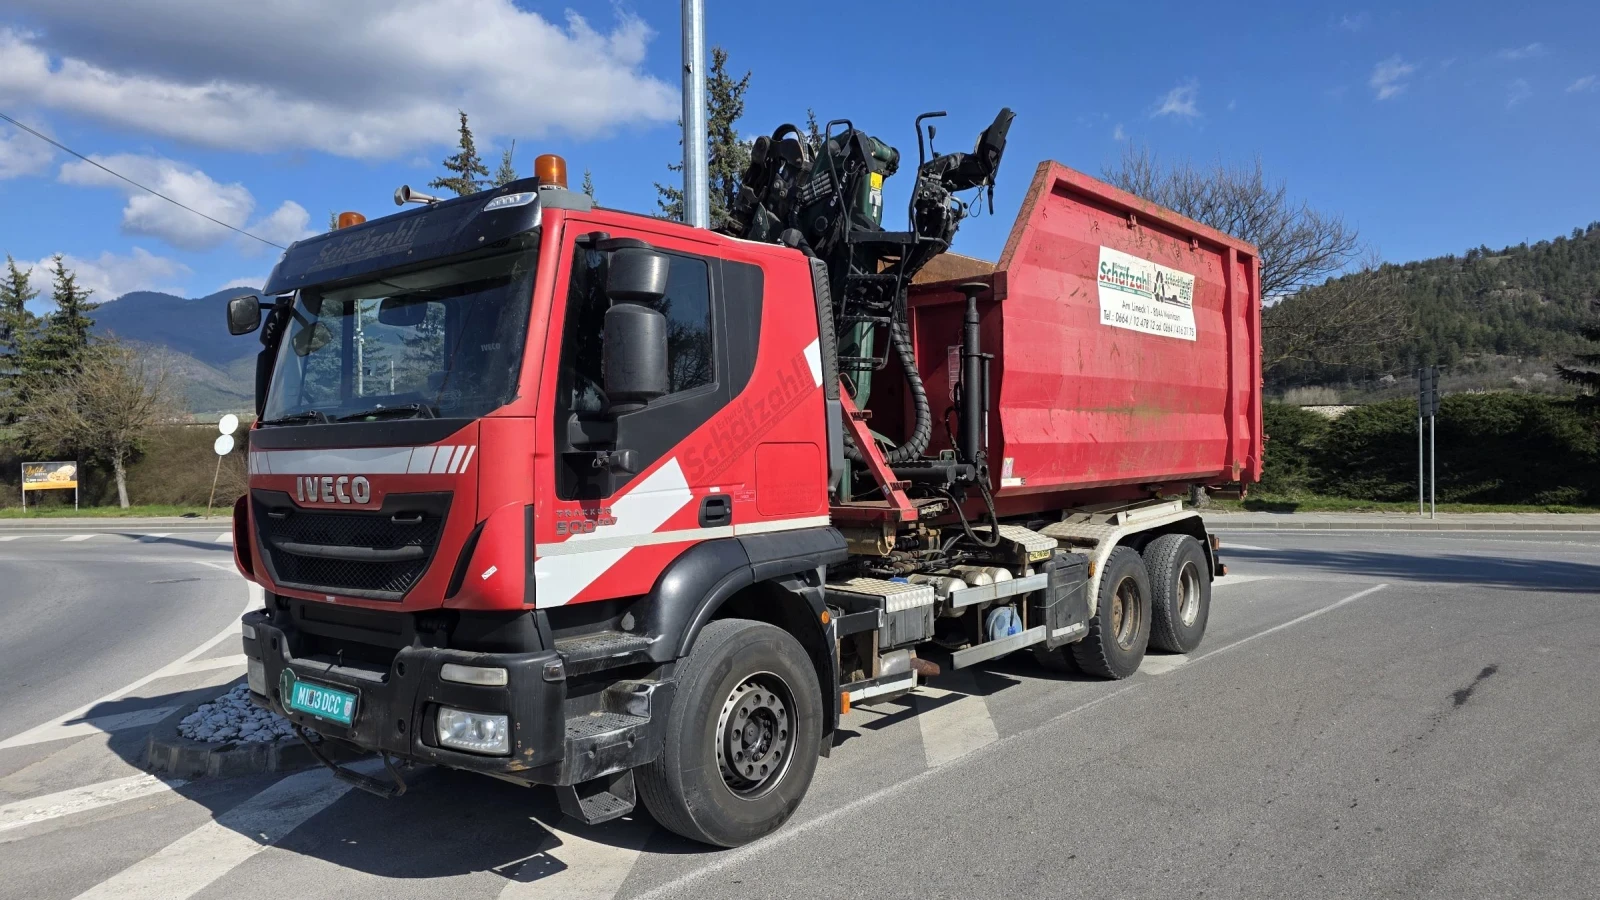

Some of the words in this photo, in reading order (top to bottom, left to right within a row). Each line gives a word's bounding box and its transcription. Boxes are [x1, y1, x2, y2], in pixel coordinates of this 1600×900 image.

[1100, 261, 1150, 292] Schafzahl
[1116, 312, 1128, 323] 0664
[480, 342, 501, 352] IVECO
[683, 356, 807, 482] Schafzahl
[296, 475, 371, 504] IVECO
[556, 507, 612, 518] TRAKKER
[556, 519, 597, 536] 500
